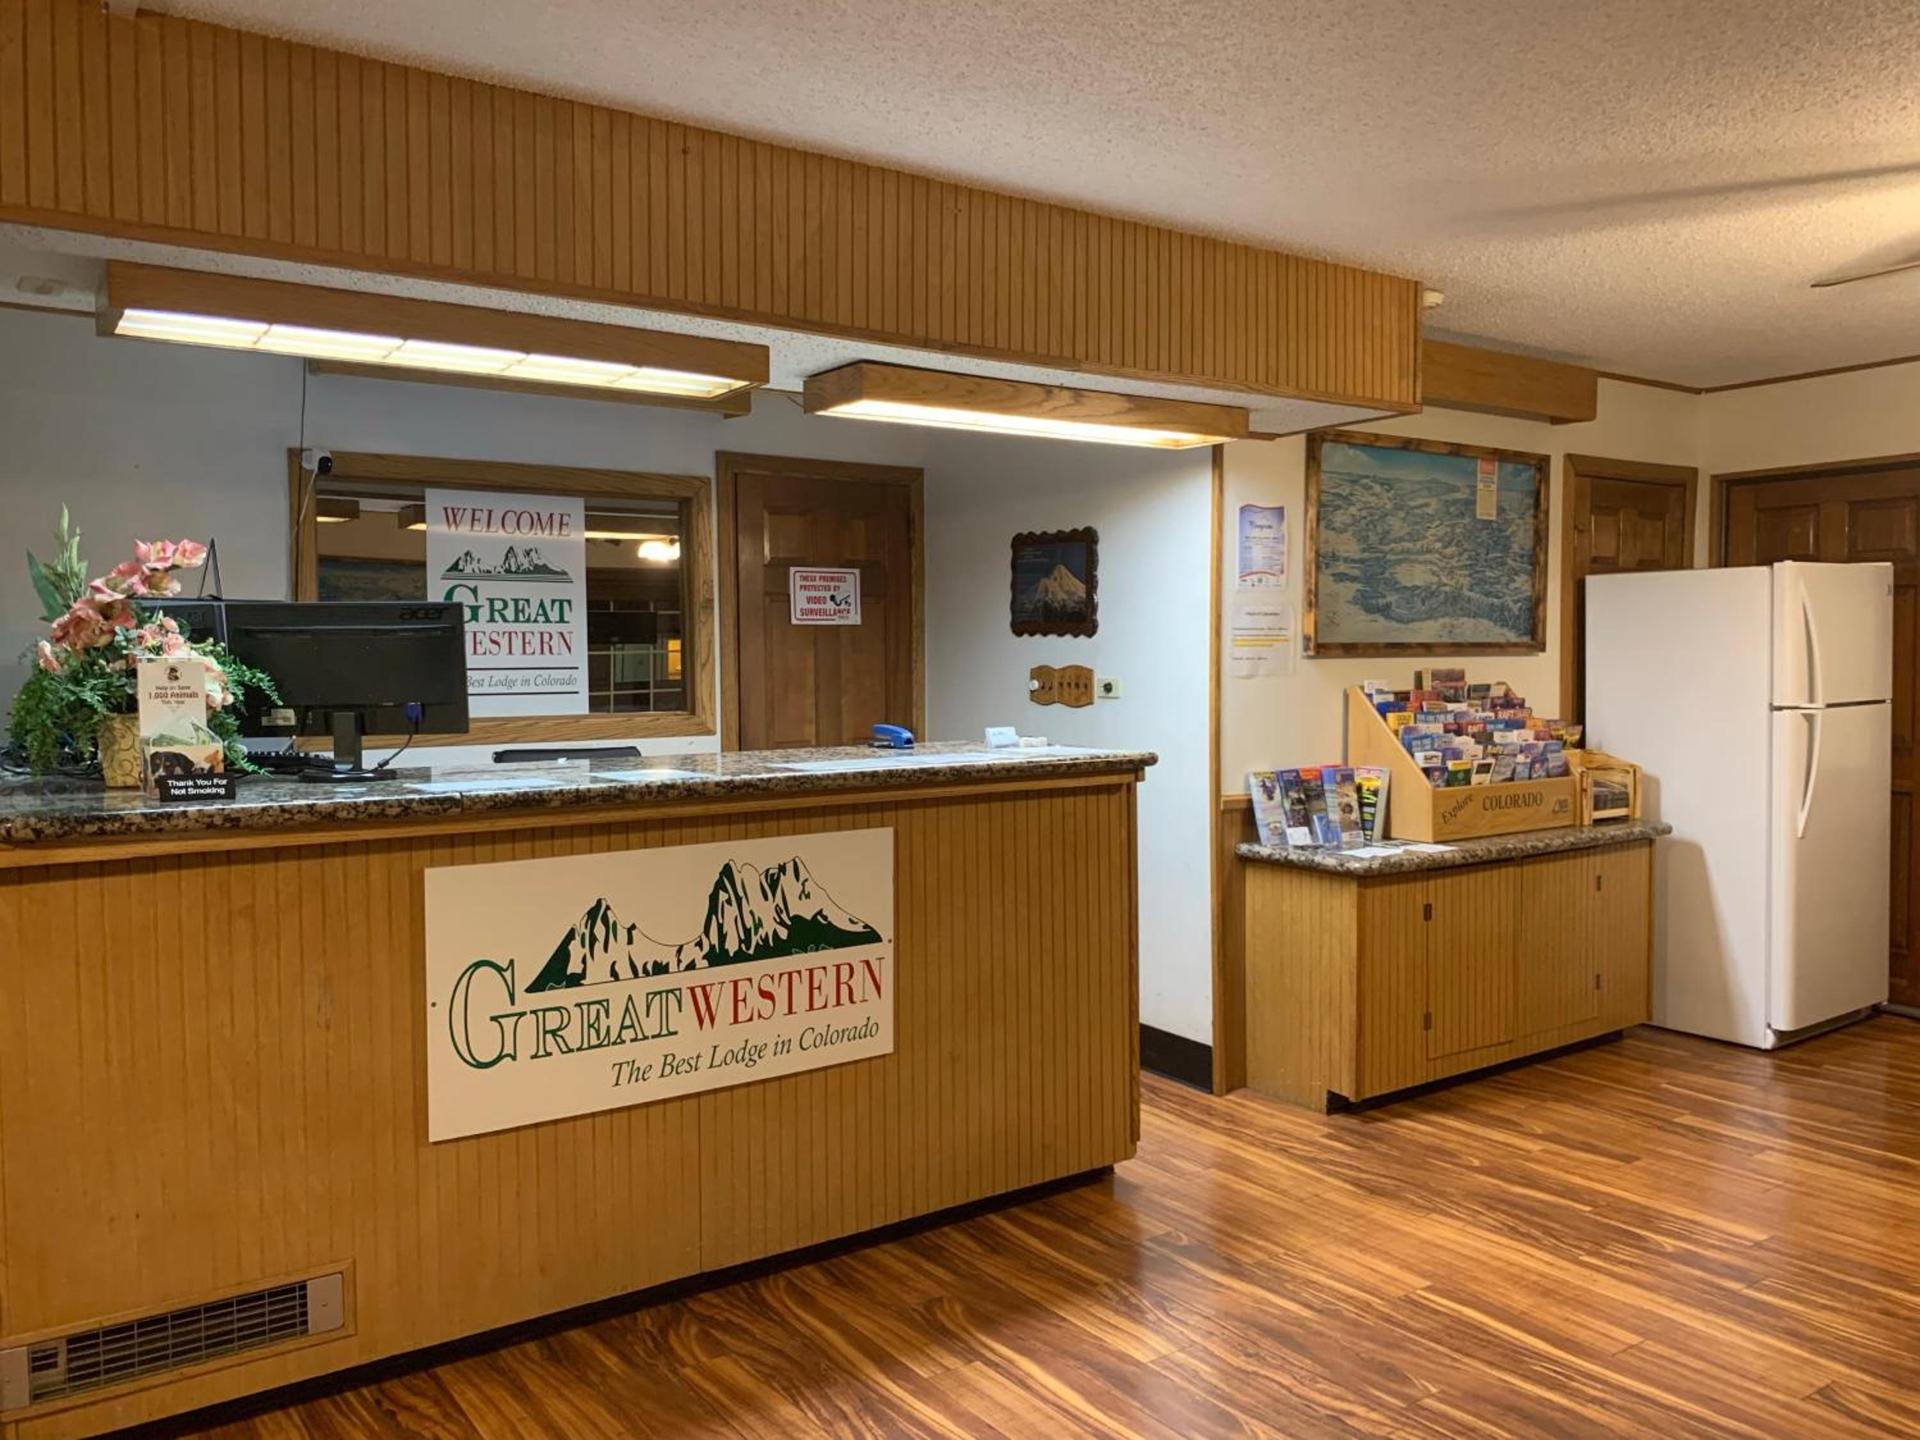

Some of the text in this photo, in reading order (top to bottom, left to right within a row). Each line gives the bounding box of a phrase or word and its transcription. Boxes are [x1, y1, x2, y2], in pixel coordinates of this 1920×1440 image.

[443, 506, 571, 537] WELCOME
[443, 584, 572, 624] GREAT
[805, 595, 828, 605] VIDEO
[399, 607, 450, 619] acer
[799, 607, 851, 617] SURVEILLANCE
[465, 630, 573, 656] ESTERN
[488, 675, 519, 690] Lodge
[520, 675, 531, 687] in
[534, 674, 578, 687] Colorado
[167, 777, 228, 787] Thank You For
[171, 787, 226, 796] Not Smoking
[1441, 793, 1474, 825] Explore
[1482, 792, 1544, 811] COLORADO
[449, 957, 885, 1070] GREAT WESTERN
[611, 1016, 880, 1088] The Best Lodge in Colorado
